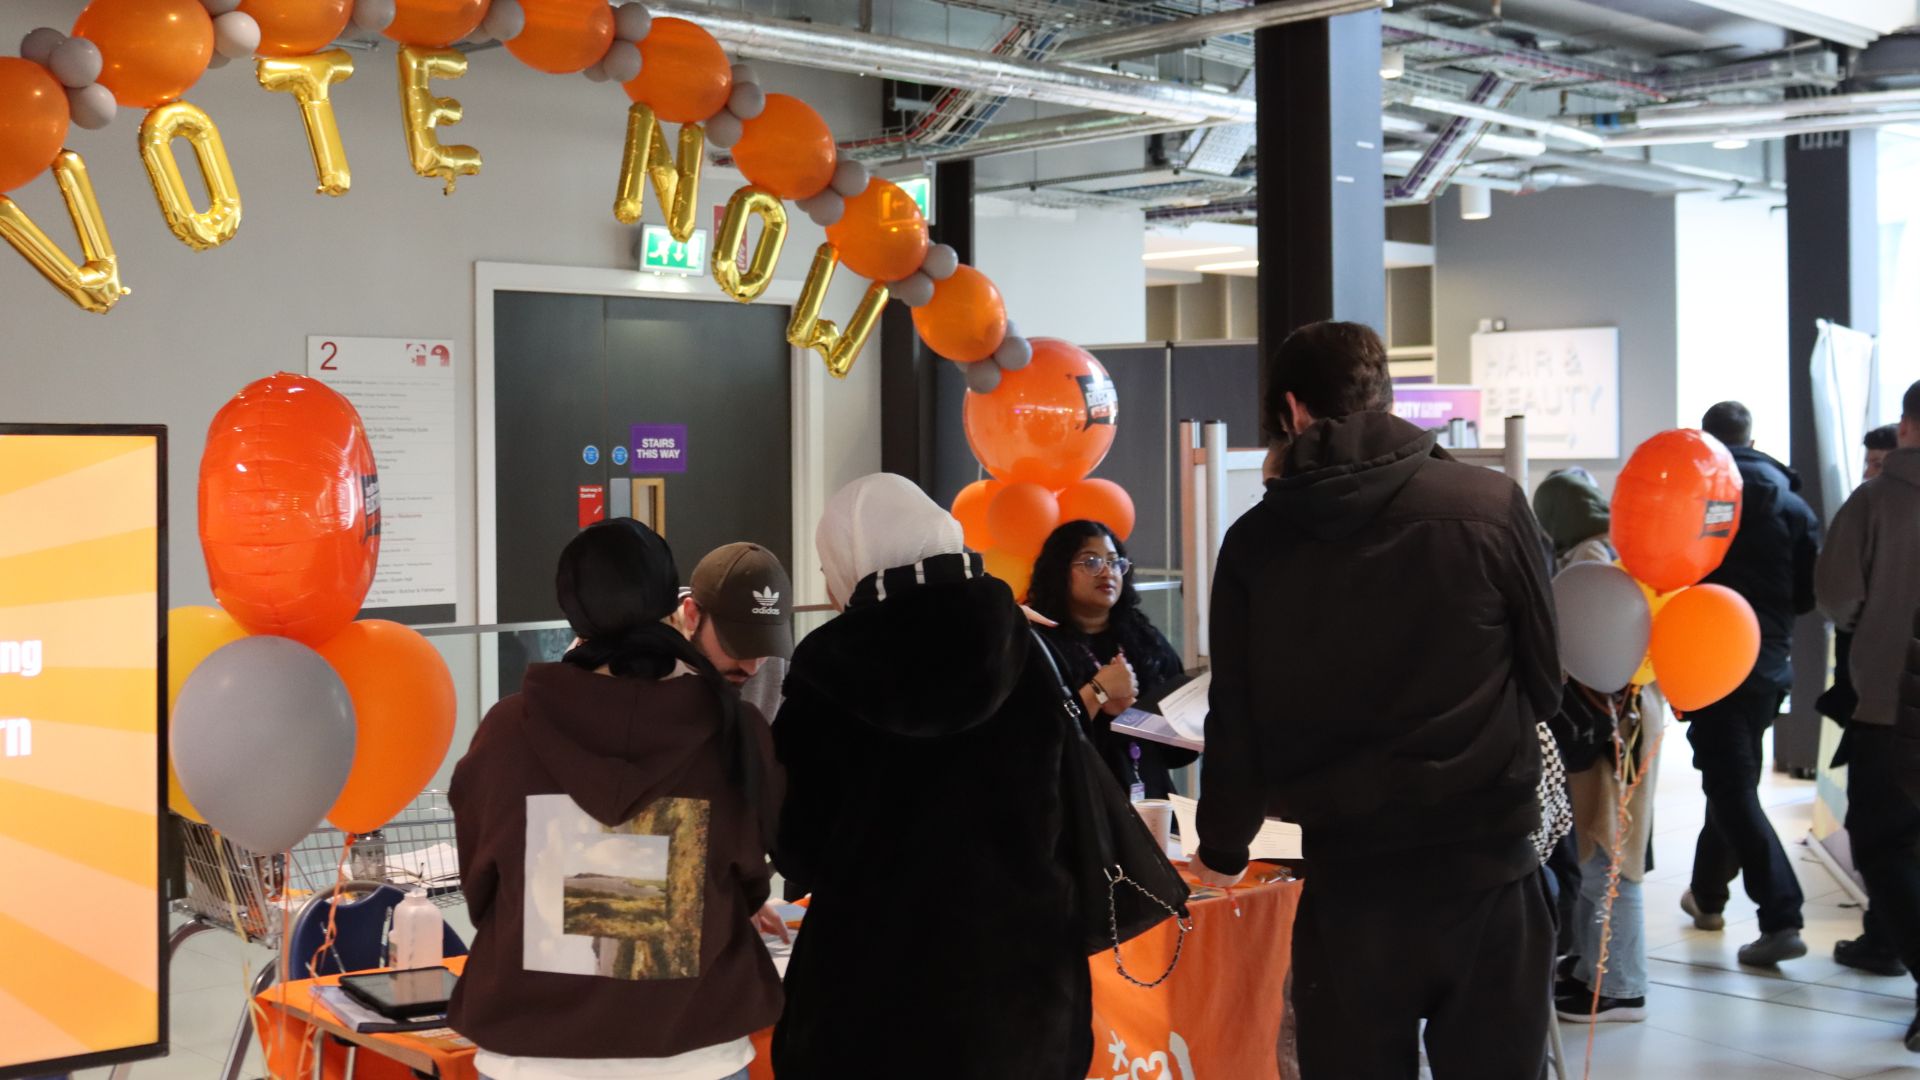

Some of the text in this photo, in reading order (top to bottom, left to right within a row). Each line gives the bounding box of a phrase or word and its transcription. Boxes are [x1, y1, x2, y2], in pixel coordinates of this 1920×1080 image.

[0, 44, 889, 378] VOTE NOW
[320, 341, 338, 371] 2
[642, 438, 675, 448] STAIRS
[636, 449, 658, 459] THIS
[659, 449, 680, 459] WAY
[752, 606, 780, 615] adidas
